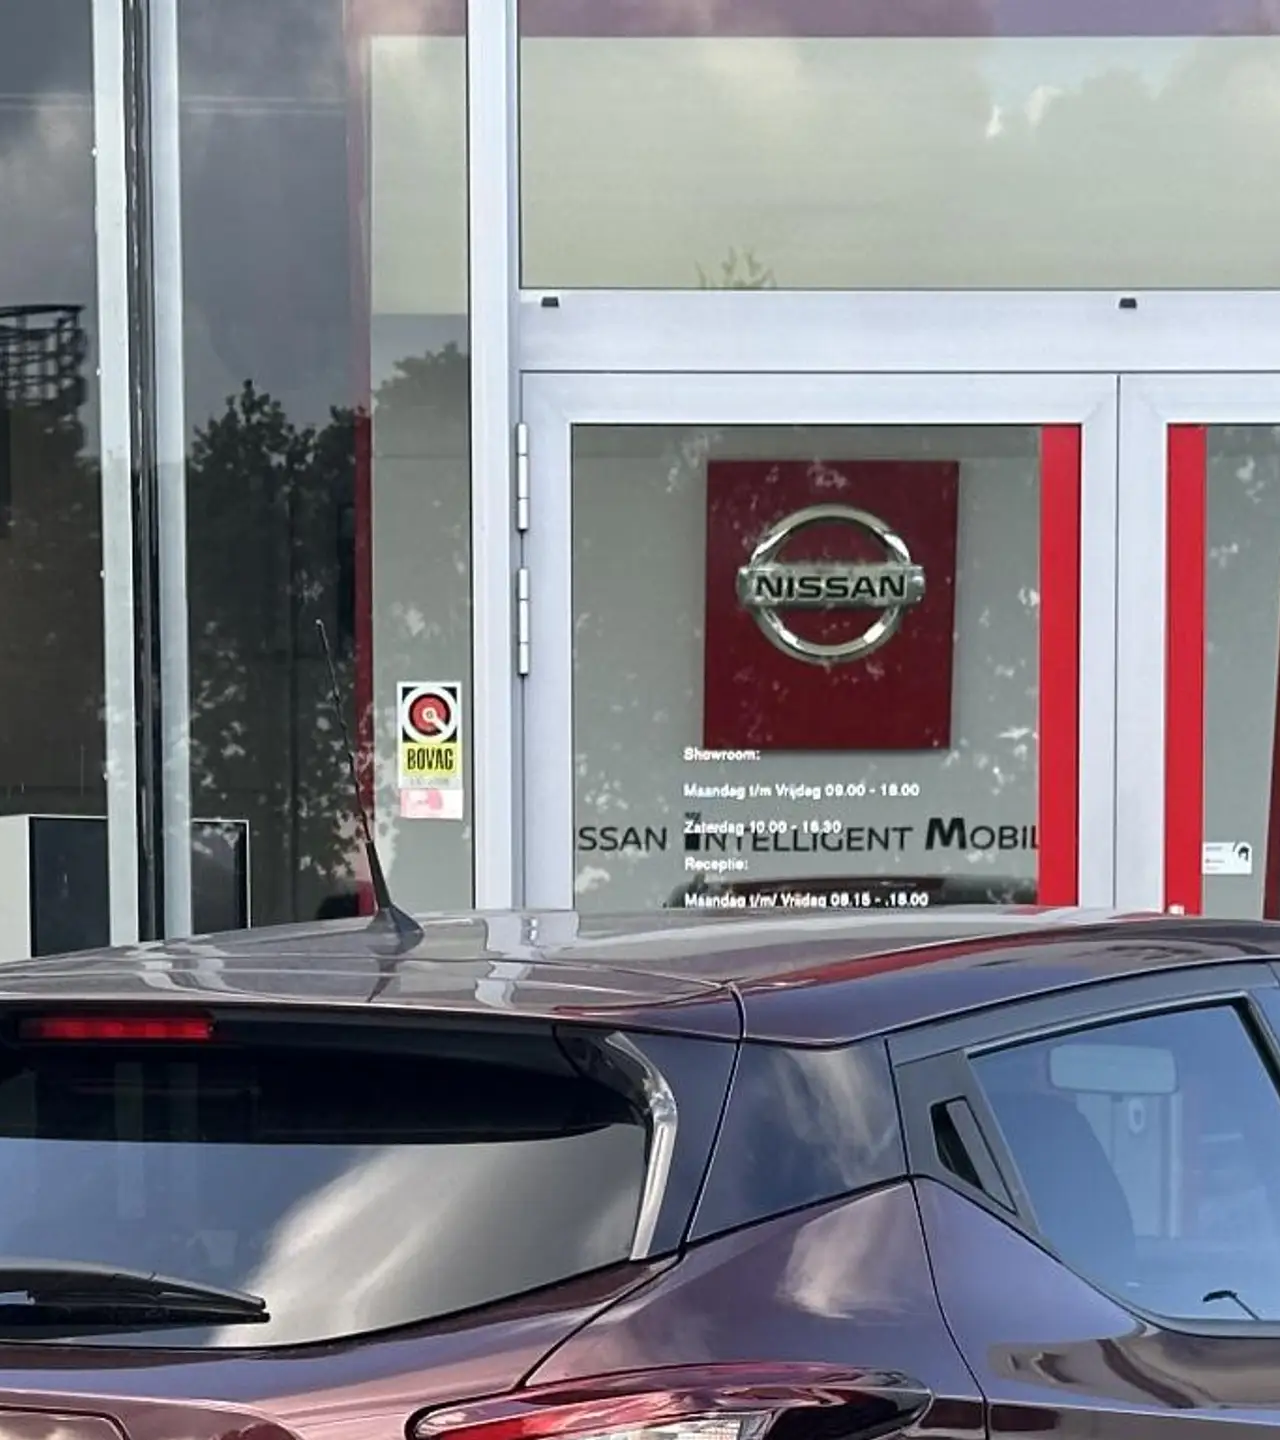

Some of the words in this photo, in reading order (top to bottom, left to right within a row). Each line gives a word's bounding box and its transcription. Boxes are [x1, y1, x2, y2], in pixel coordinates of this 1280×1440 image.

[755, 574, 906, 599] NISSAN
[406, 747, 454, 771] BOVAG
[683, 747, 761, 761] Showroom:
[683, 783, 746, 799] Maandag
[748, 783, 772, 797] t/m
[774, 783, 822, 800] Vrijdag
[824, 783, 866, 797] 09.00
[880, 783, 921, 797] 18.00
[683, 819, 745, 836] Zaterdag
[749, 819, 788, 834] 10.00
[684, 812, 914, 852] INTELLIGENT
[684, 856, 748, 873] Receptie:
[684, 891, 746, 908] Maandag
